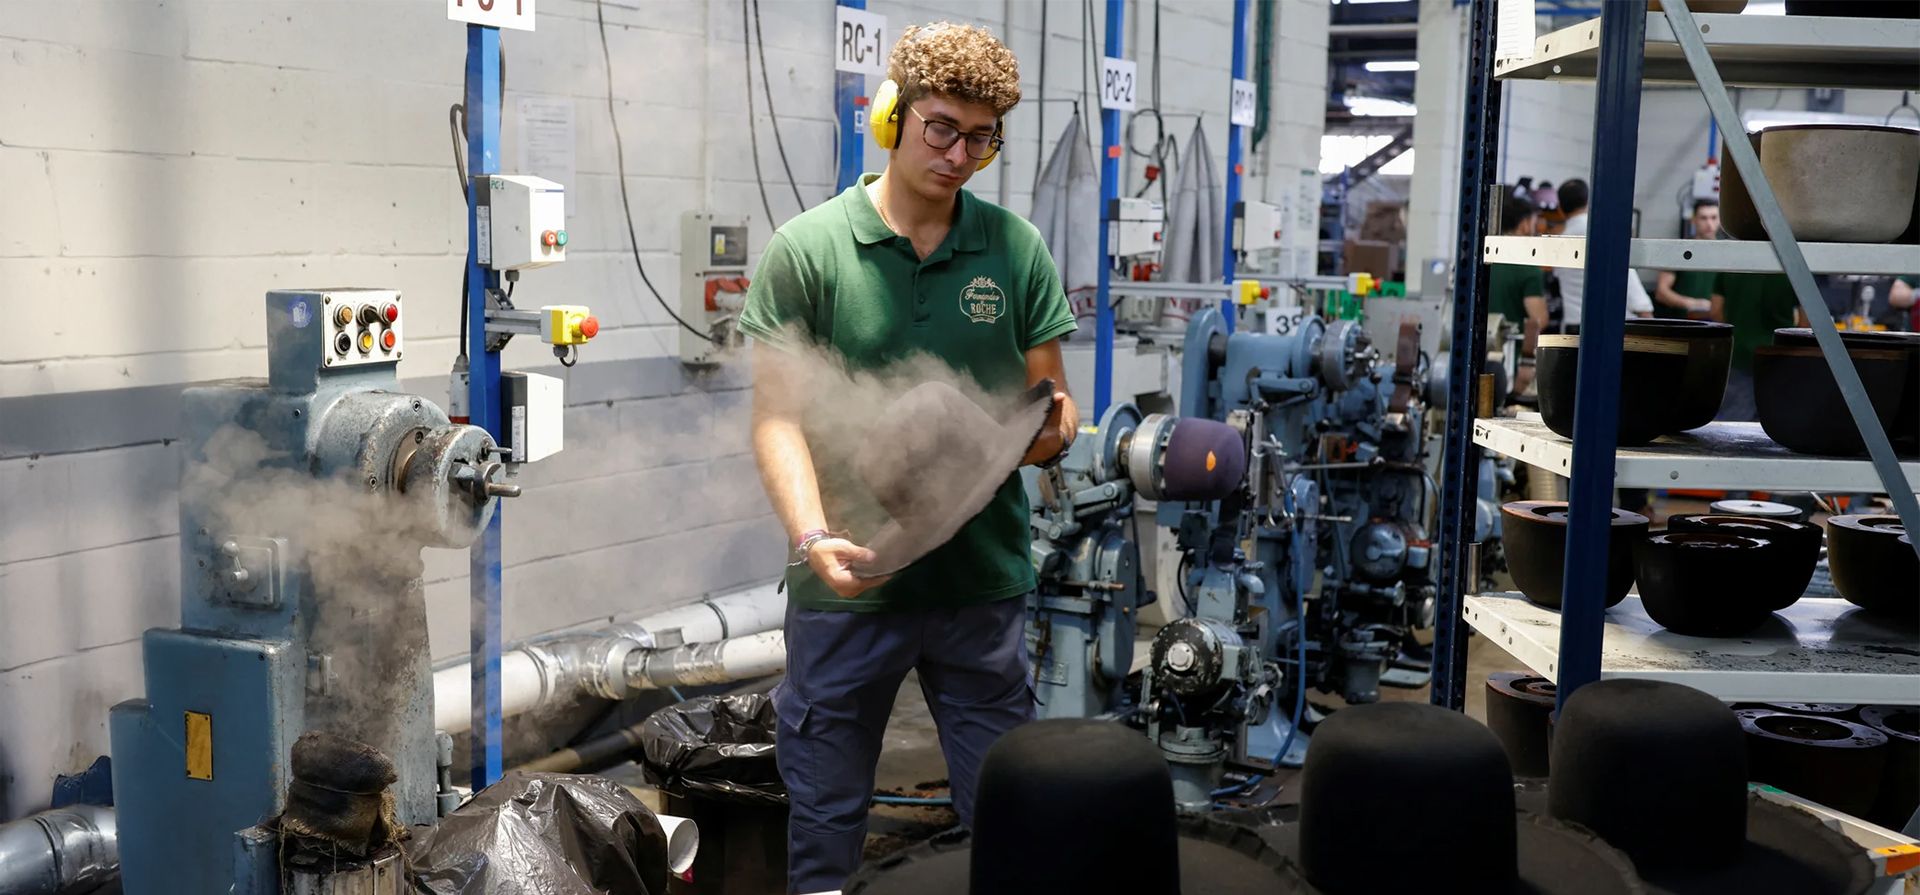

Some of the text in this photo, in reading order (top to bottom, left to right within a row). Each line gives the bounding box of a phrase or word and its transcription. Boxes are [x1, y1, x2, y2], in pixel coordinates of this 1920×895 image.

[842, 20, 881, 67] RC-1
[1105, 68, 1133, 103] PC-2
[970, 303, 996, 314] ROCHE
